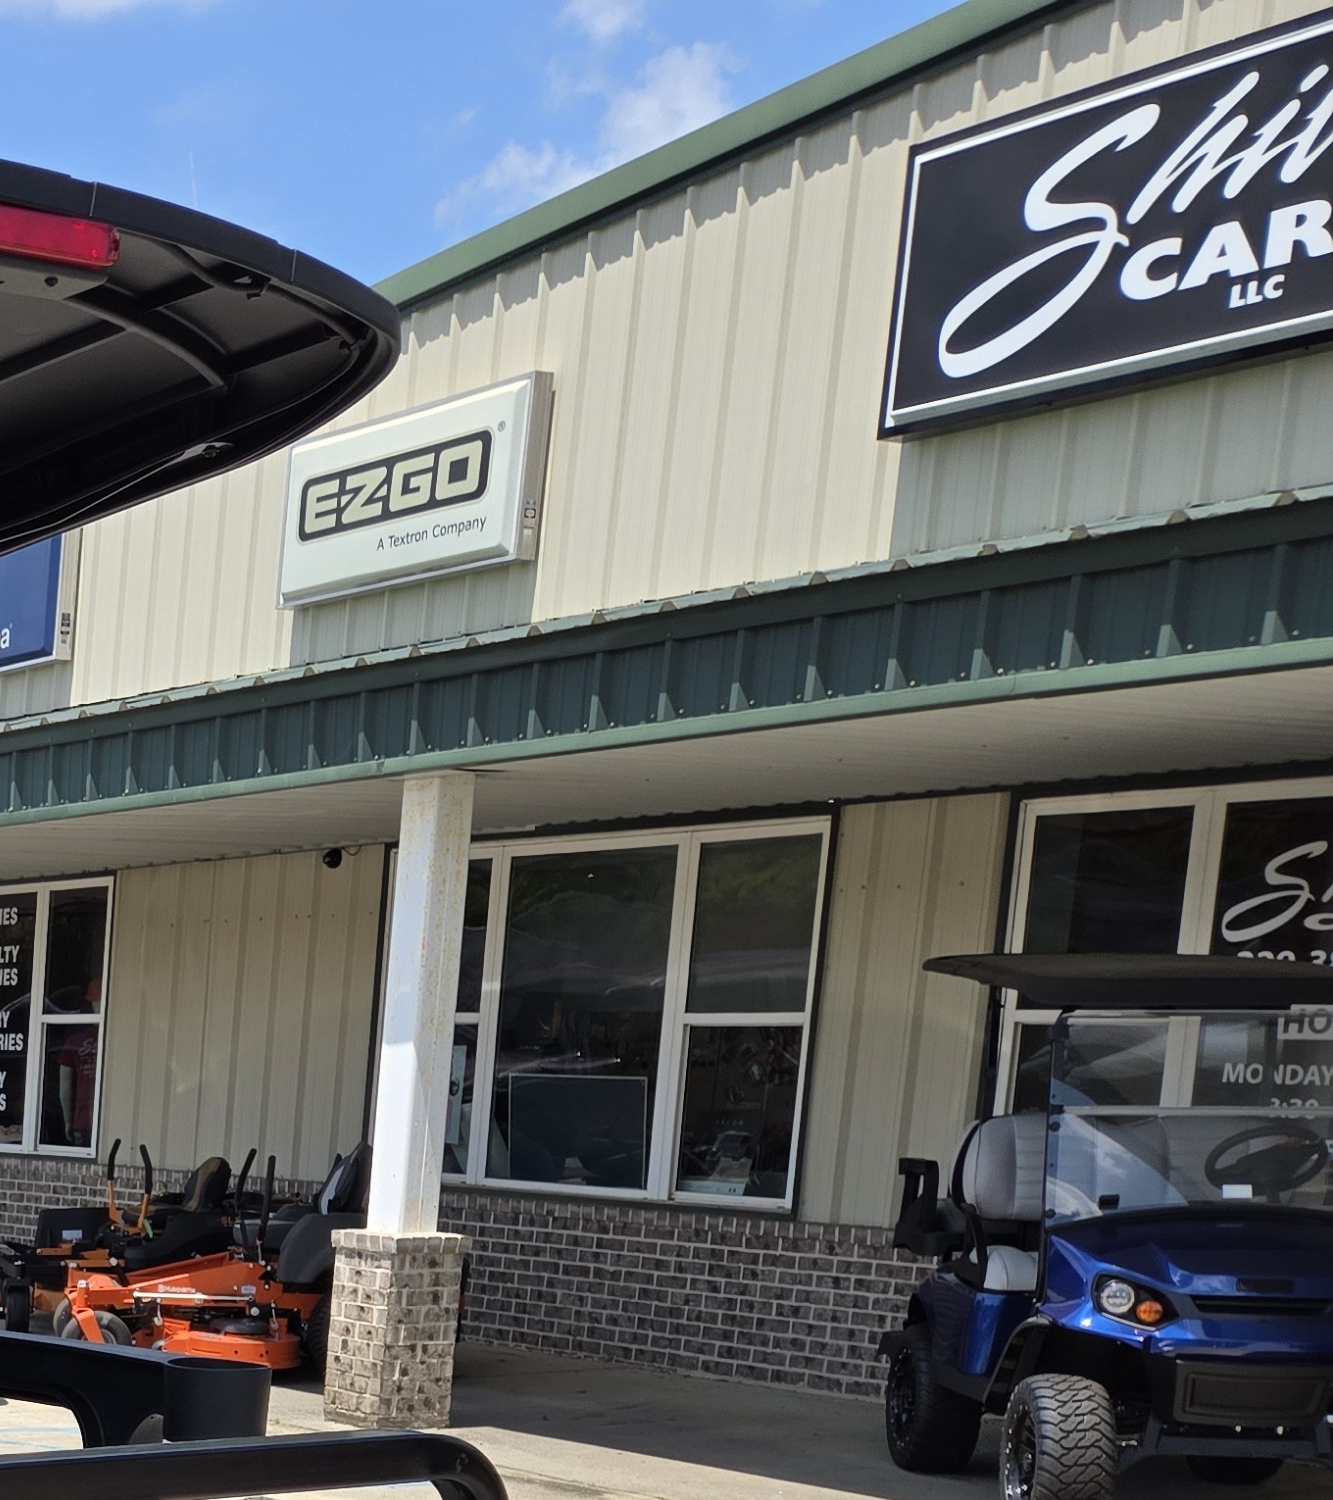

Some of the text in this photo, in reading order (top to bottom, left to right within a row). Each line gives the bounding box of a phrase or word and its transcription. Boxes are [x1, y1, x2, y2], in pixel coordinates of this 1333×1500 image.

[1229, 274, 1285, 309] LLC
[303, 438, 484, 536] EZGO
[376, 515, 487, 551] A Textron Company
